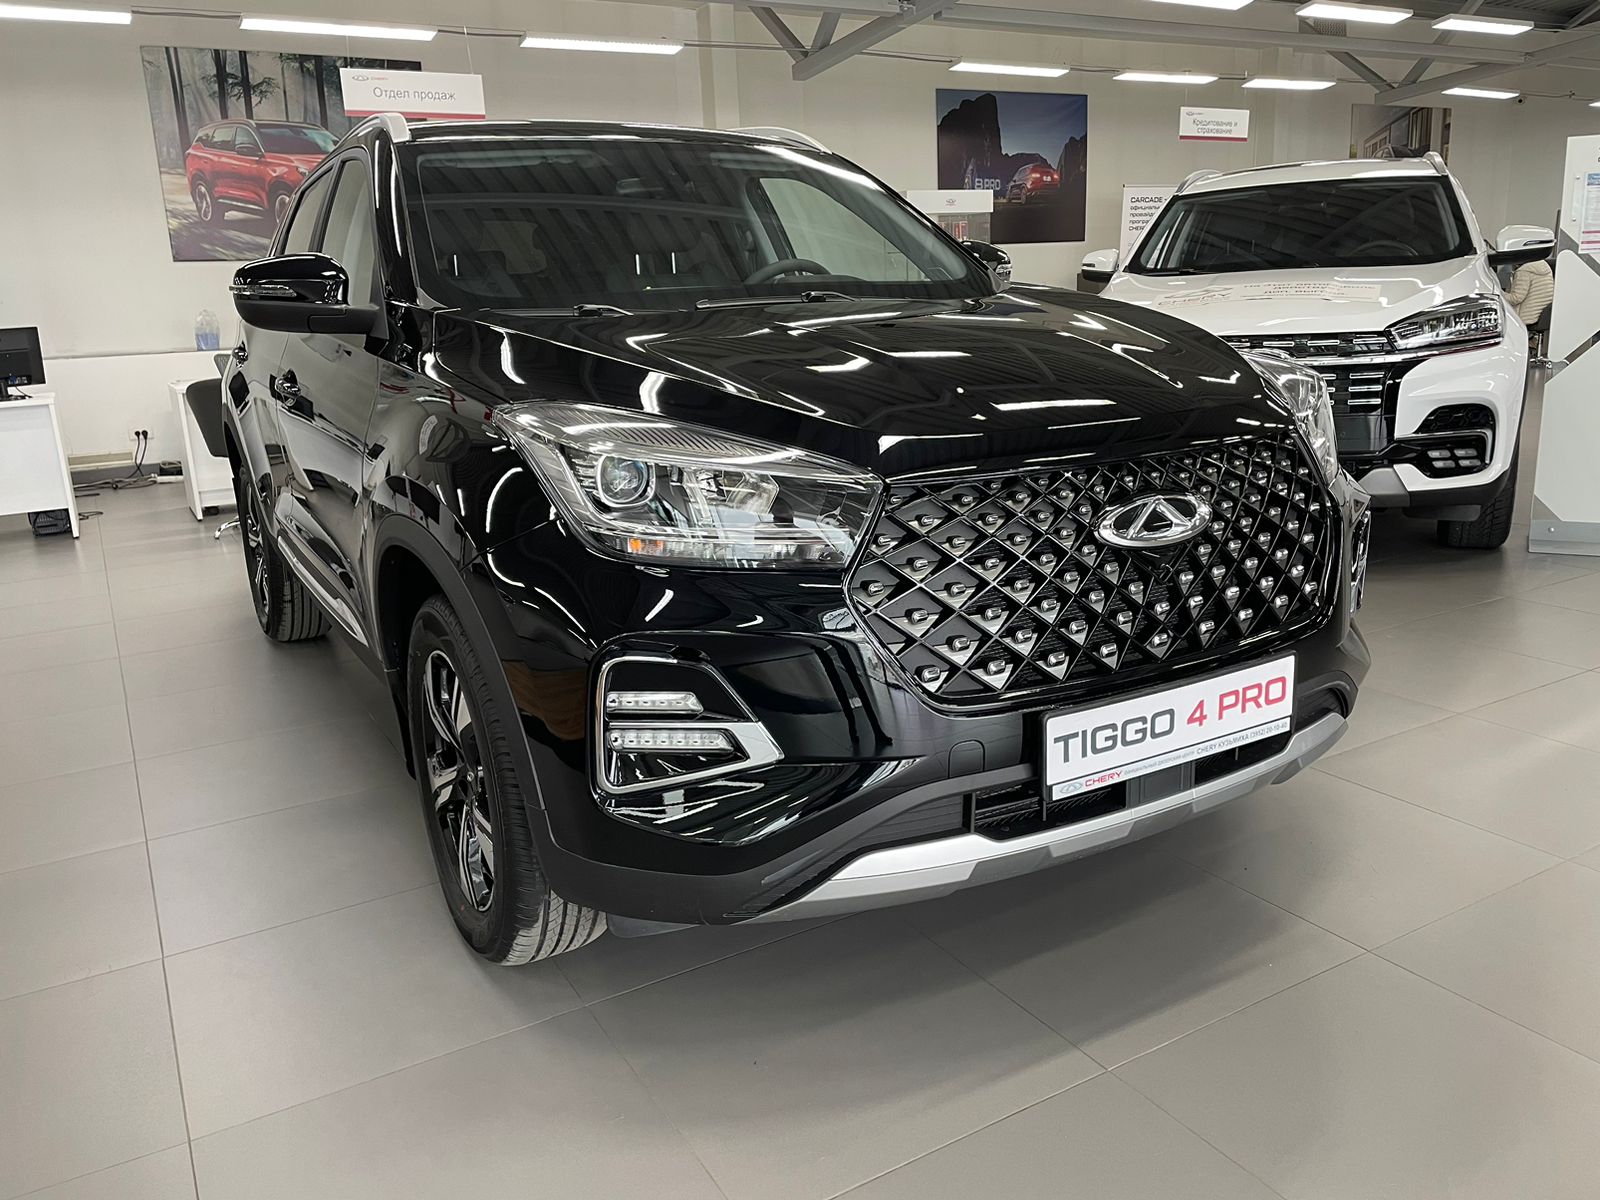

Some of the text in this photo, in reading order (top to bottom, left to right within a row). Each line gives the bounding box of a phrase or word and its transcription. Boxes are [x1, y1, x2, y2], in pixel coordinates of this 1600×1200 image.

[373, 86, 456, 101] Отдел продаж
[1053, 676, 1287, 764] TIGGO 4 PRO
[1084, 770, 1122, 788] CHERY
[1196, 742, 1217, 755] CHERY
[1218, 733, 1249, 750] КУЗЬМИХА
